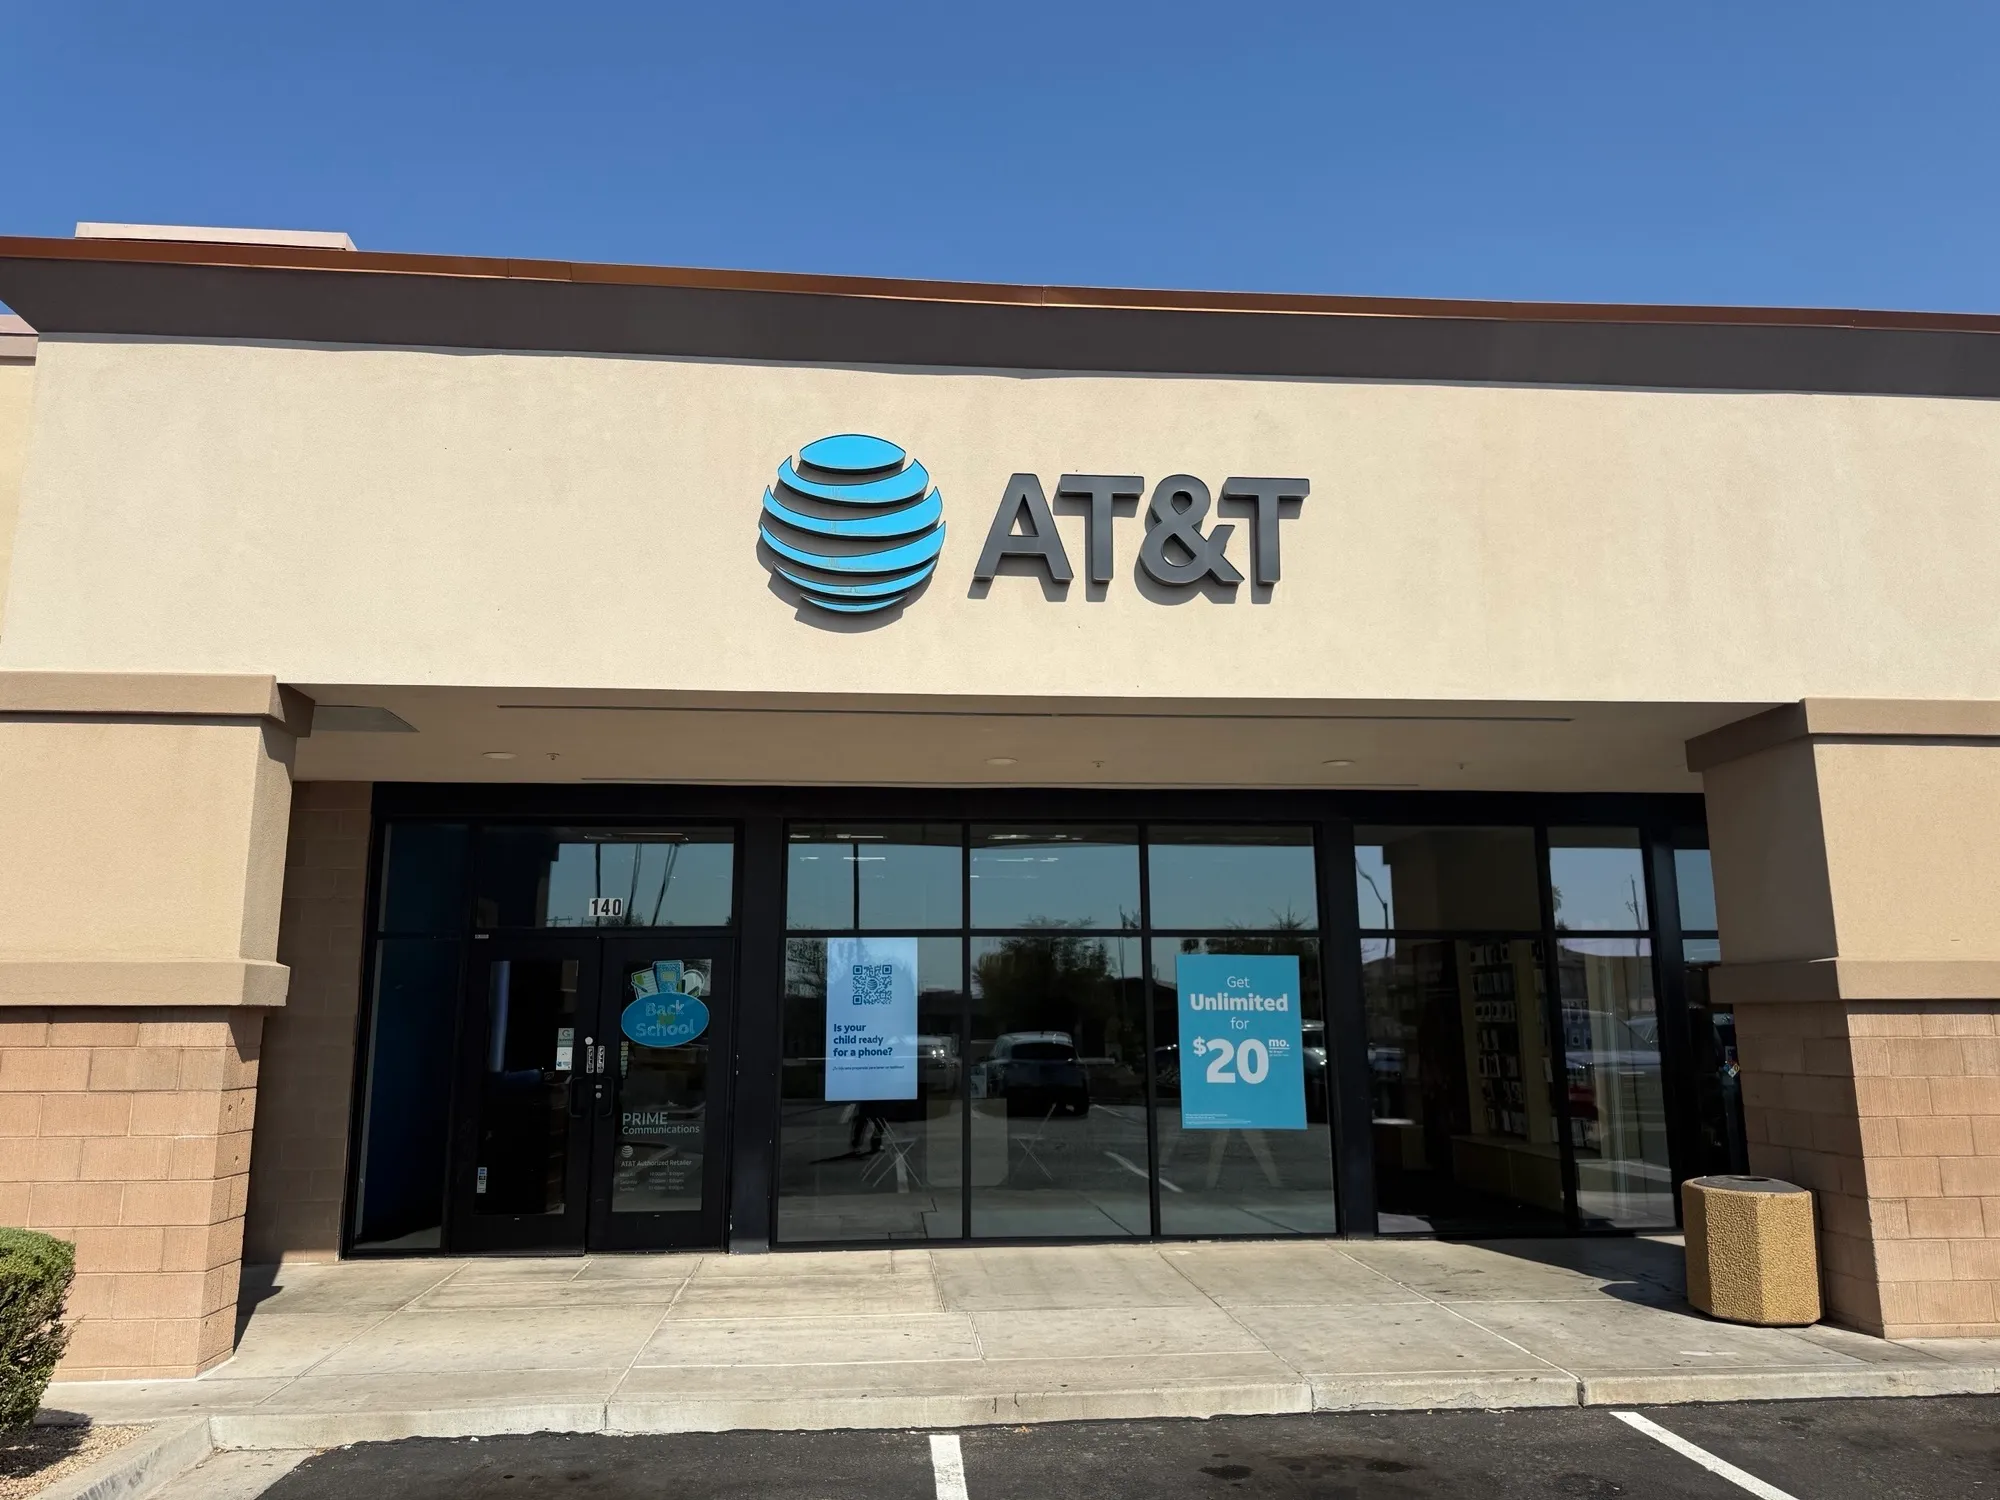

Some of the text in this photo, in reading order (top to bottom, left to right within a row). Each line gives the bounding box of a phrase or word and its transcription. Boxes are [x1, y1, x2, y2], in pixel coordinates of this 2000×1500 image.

[973, 473, 1310, 586] AT&T
[591, 898, 622, 916] 140
[1226, 976, 1250, 988] Get
[645, 1000, 685, 1016] Back
[1190, 992, 1289, 1012] Unlimited
[635, 1019, 695, 1037] School
[833, 1024, 866, 1034] Is your
[1230, 1017, 1250, 1030] for
[833, 1034, 884, 1046] child ready
[833, 1047, 893, 1058] for a phone?
[1192, 1036, 1290, 1084] $20 mo.
[622, 1112, 668, 1125] PRIME
[622, 1125, 700, 1135] Communications
